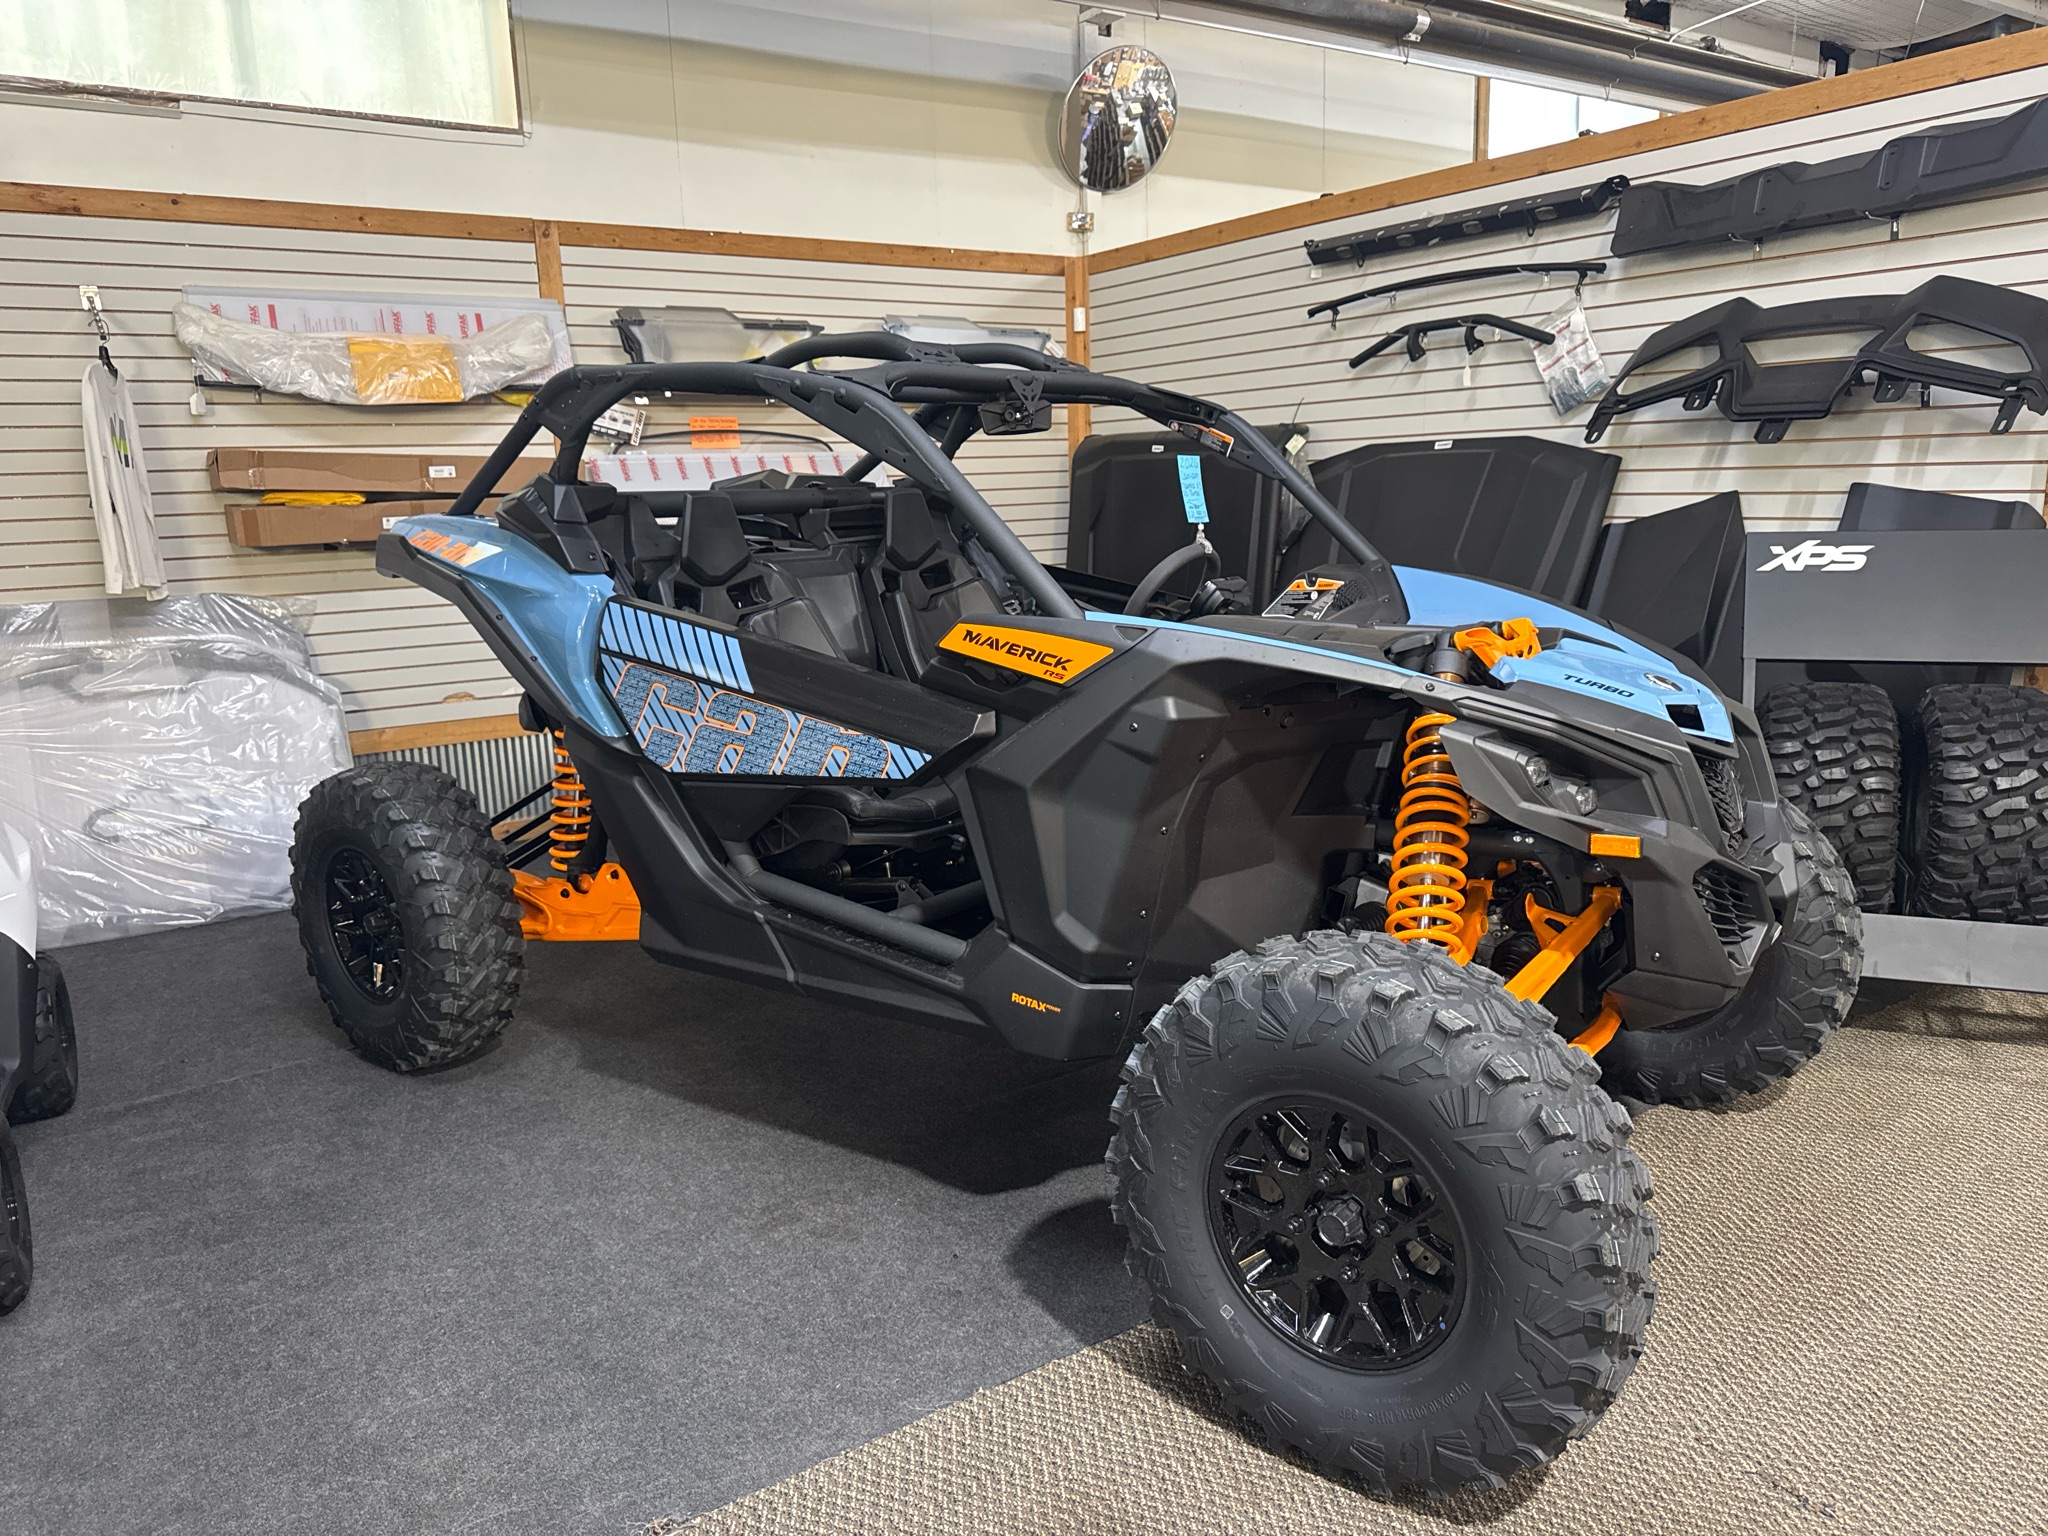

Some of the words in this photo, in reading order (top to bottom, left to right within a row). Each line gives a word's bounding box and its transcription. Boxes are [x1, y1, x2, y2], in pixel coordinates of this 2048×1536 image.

[457, 312, 469, 339] UFFAK
[1756, 540, 1875, 571] XPS
[962, 629, 1073, 672] MAVERICK
[1043, 669, 1066, 680] RS
[1563, 673, 1635, 698] TURBO
[1011, 992, 1046, 1012] ROTAX
